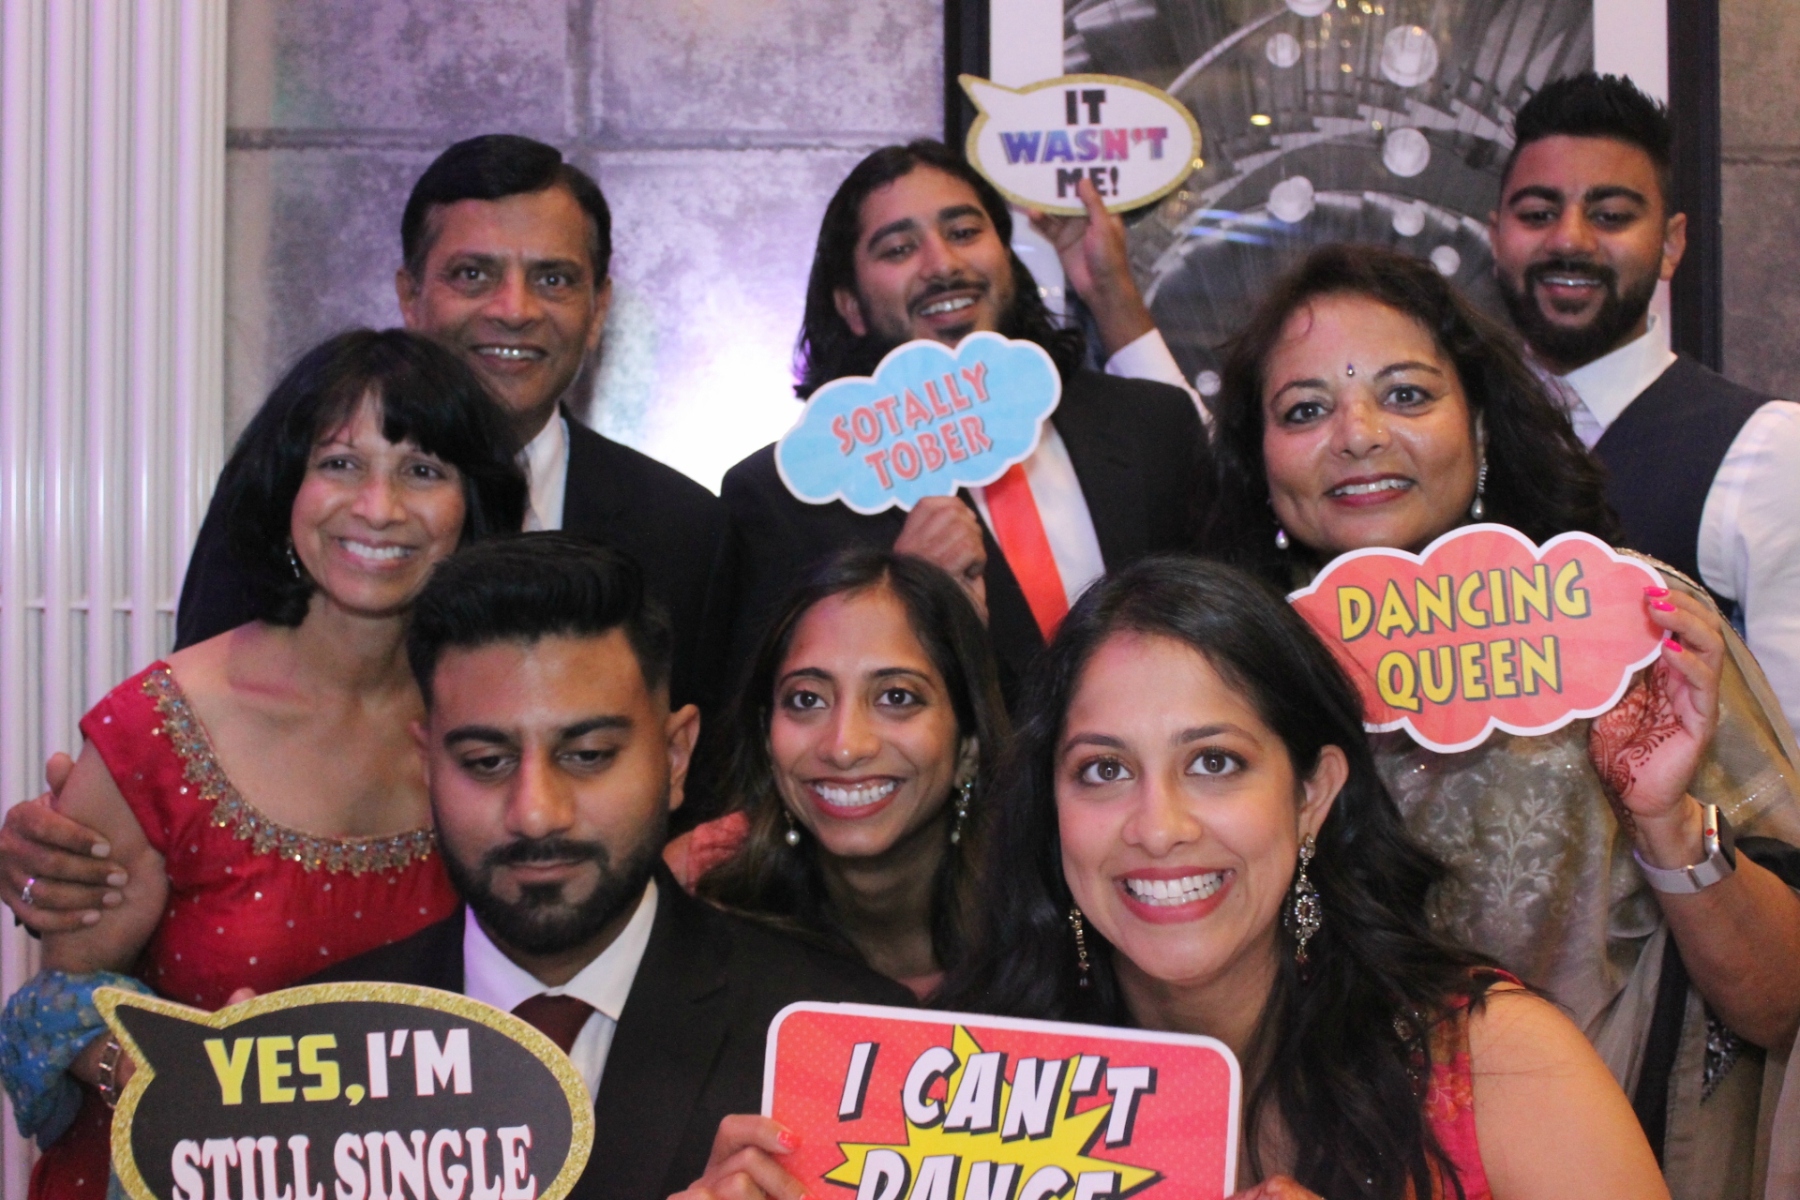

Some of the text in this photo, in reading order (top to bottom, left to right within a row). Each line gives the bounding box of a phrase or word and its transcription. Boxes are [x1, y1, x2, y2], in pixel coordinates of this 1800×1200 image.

[999, 126, 1168, 165] WASN'T
[1065, 89, 1107, 126] IT
[831, 361, 991, 456] SOTALLY
[864, 415, 993, 489] TOBER
[1337, 558, 1592, 642] DANCING
[1376, 635, 1563, 714] QUEEN
[203, 1028, 473, 1106] YES, I'M
[837, 1041, 1158, 1149] I CAN'T
[171, 1124, 538, 1200] STILL SINGLE
